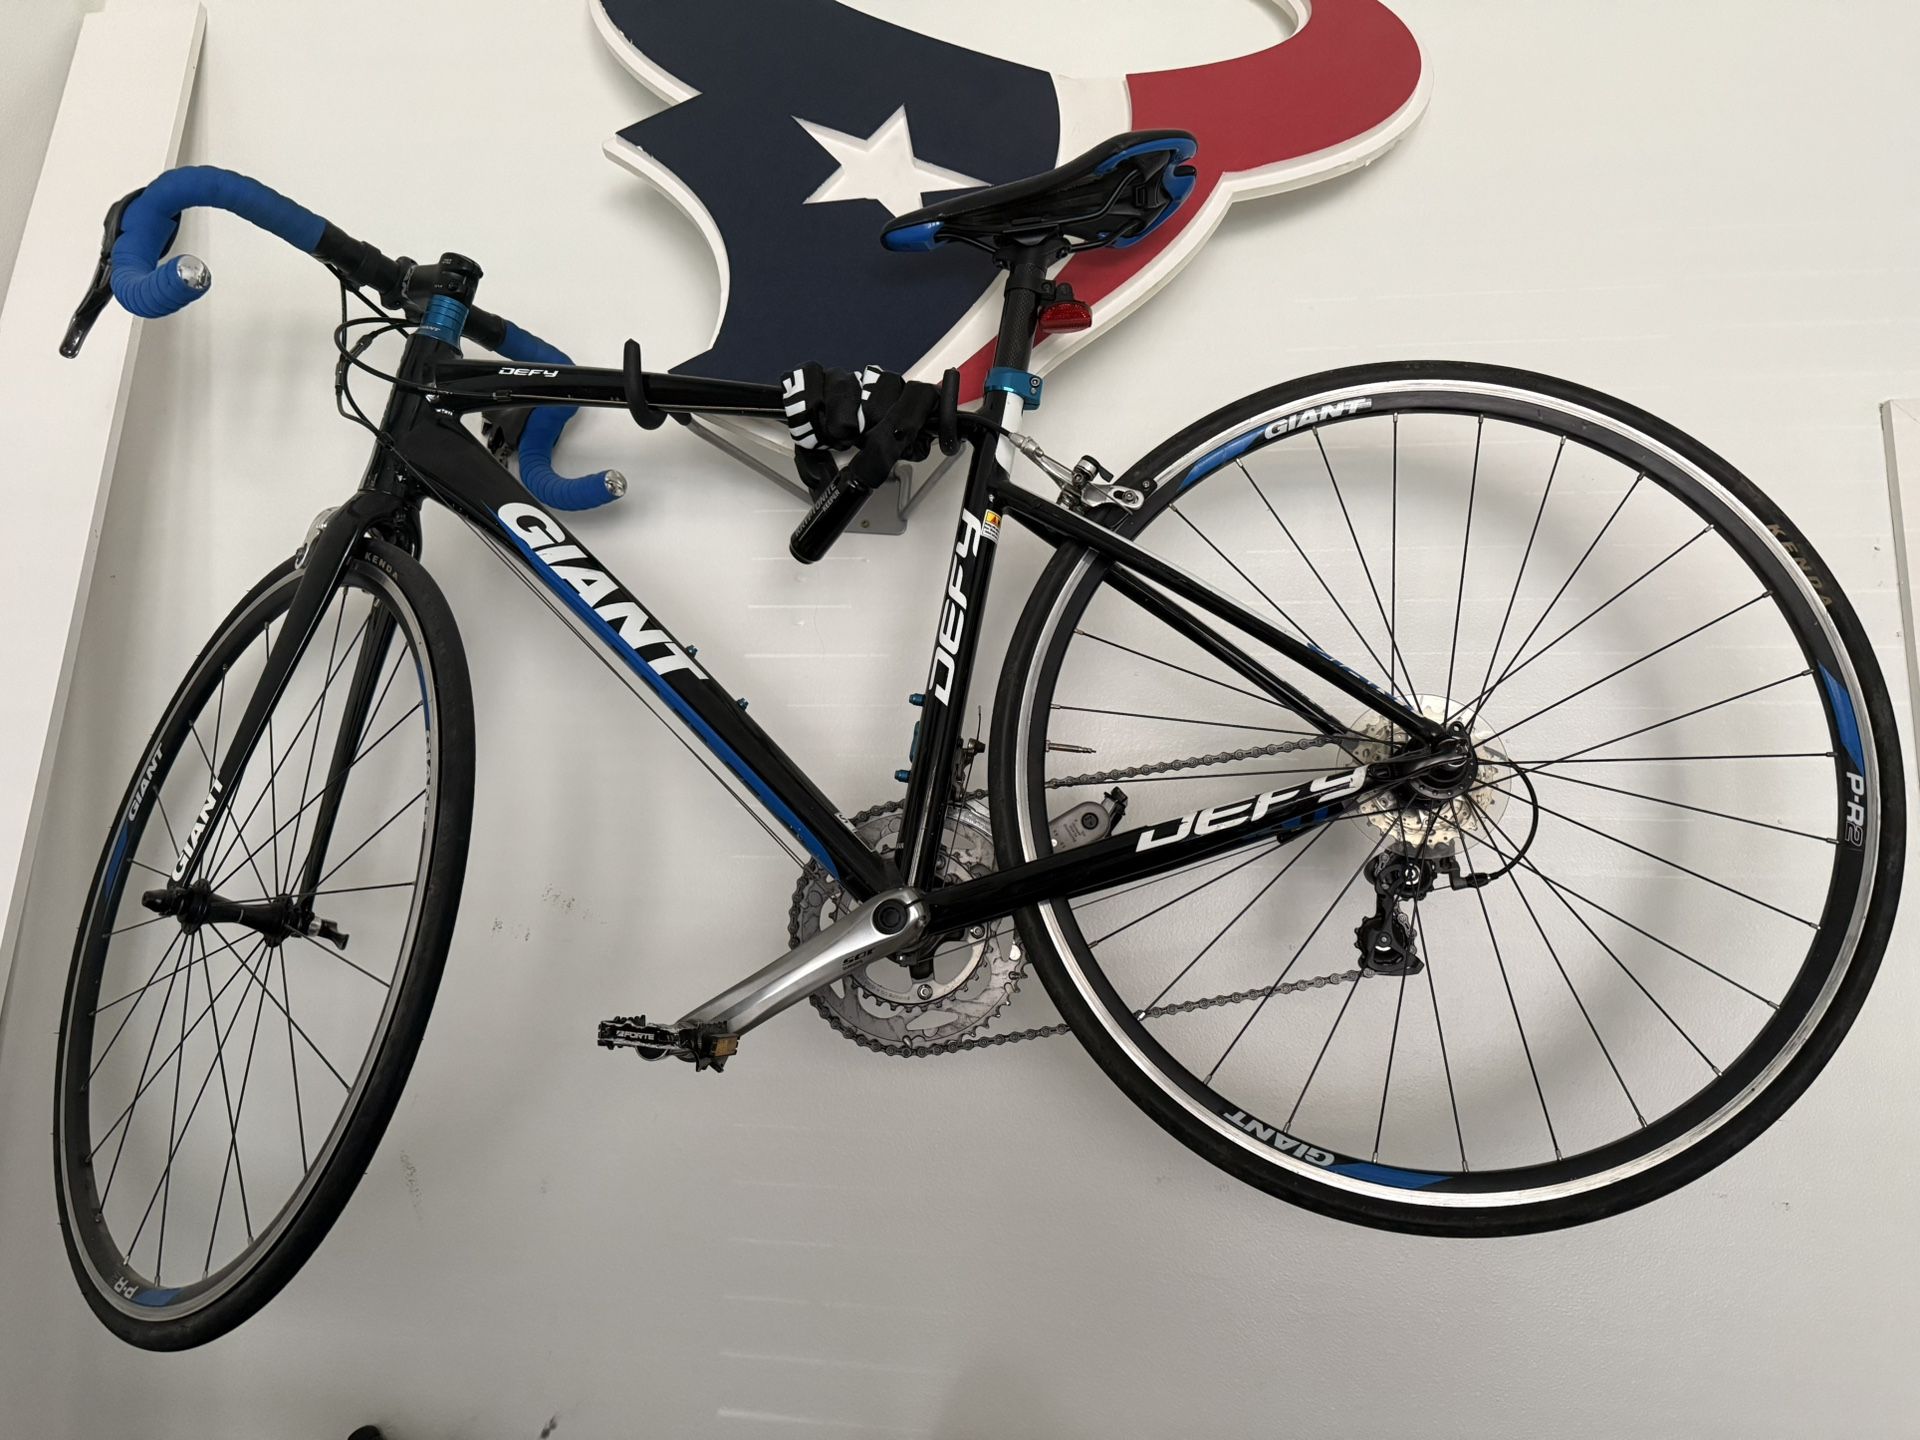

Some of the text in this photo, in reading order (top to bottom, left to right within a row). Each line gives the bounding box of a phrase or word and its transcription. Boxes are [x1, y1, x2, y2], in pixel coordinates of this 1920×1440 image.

[499, 367, 559, 378] DEFY
[1264, 397, 1368, 440] GIANT
[364, 551, 399, 581] KENDA
[498, 502, 709, 679] GIANT
[1767, 523, 1833, 606] KENDA
[929, 508, 982, 707] DEFY
[128, 742, 164, 822] GIANT
[1135, 764, 1369, 852] DEFY
[1845, 771, 1865, 847] P-R2
[171, 778, 224, 882] GIANT
[1223, 1110, 1336, 1167] GIANT
